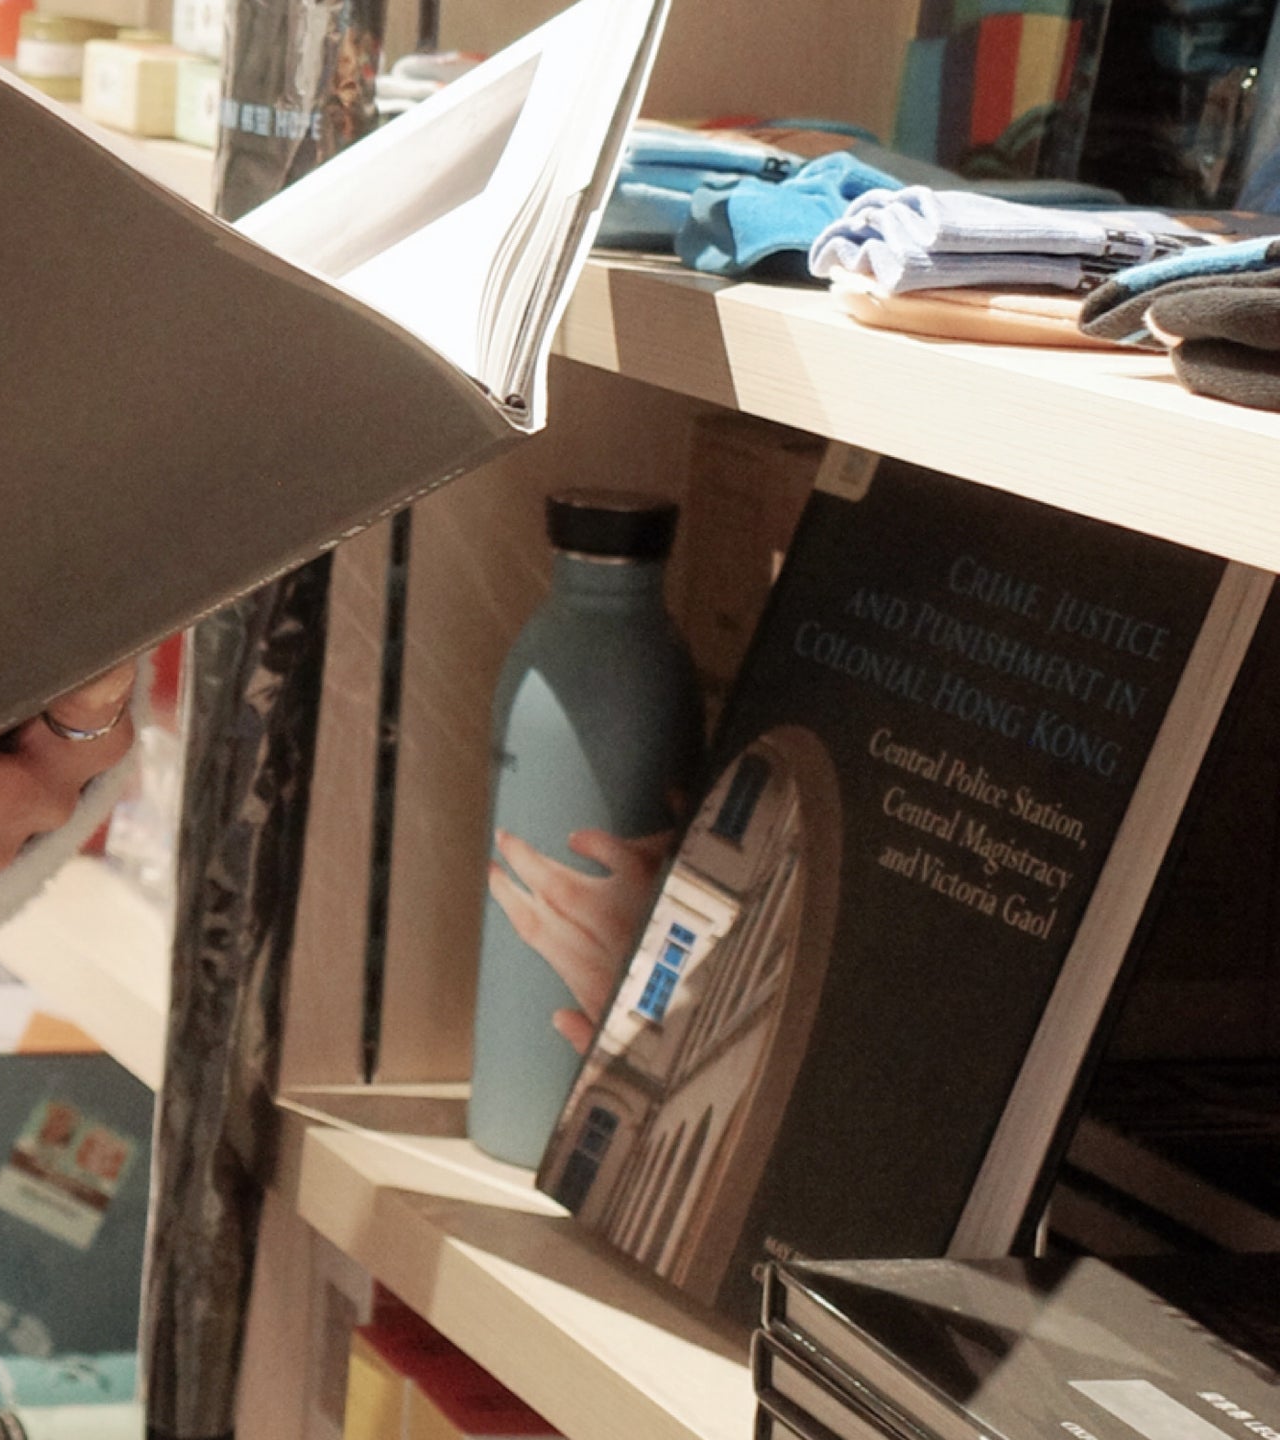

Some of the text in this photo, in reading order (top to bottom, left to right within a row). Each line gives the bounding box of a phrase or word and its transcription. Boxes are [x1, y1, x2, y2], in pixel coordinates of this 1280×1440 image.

[844, 587, 1149, 719] AND PUNISHMENT IN
[1046, 592, 1171, 663] JUSTICE
[792, 620, 1123, 778] COLONIAL HONG KONG
[868, 726, 1089, 851] Central Police Station,
[882, 786, 1074, 903] Central Magistracy
[877, 842, 1060, 941] and Victoria Gaol
